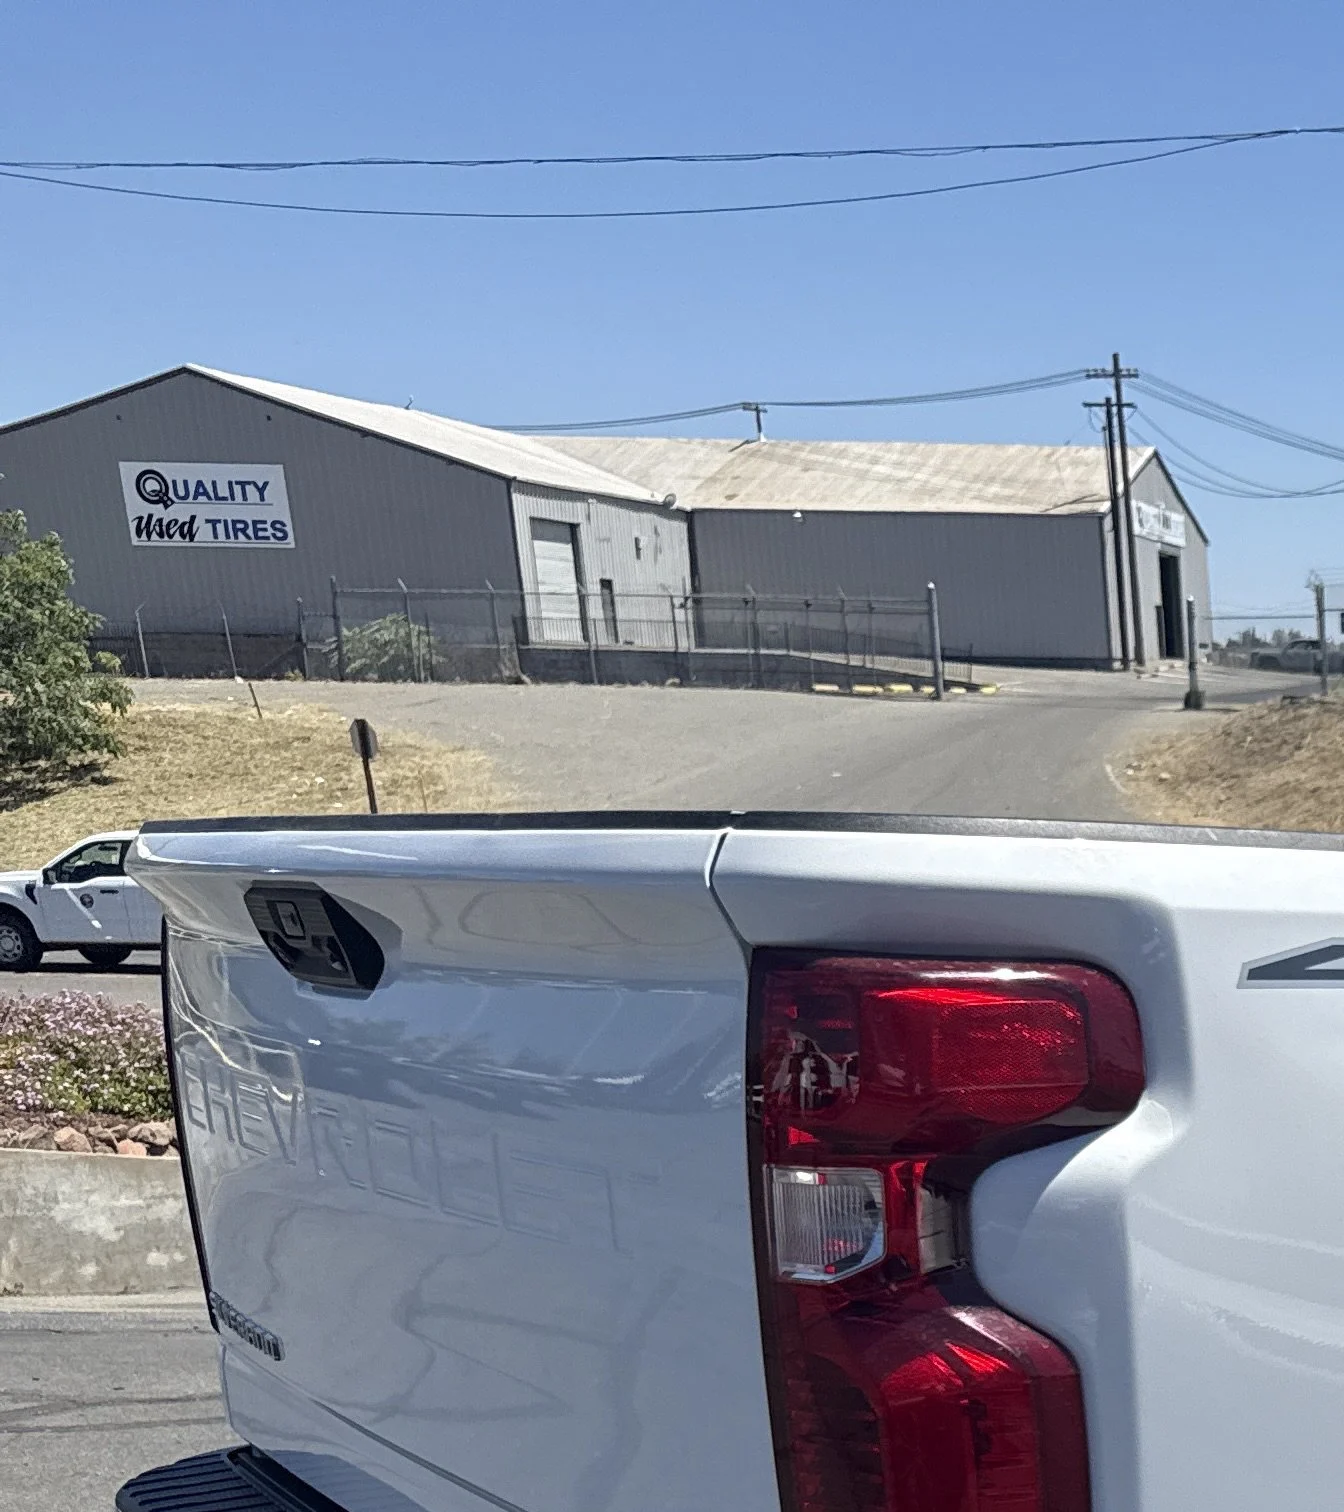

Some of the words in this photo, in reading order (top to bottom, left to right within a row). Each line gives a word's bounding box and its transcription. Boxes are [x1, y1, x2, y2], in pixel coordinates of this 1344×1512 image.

[135, 469, 270, 510] QUALITY
[131, 513, 200, 542] Used
[204, 518, 289, 542] TIRES
